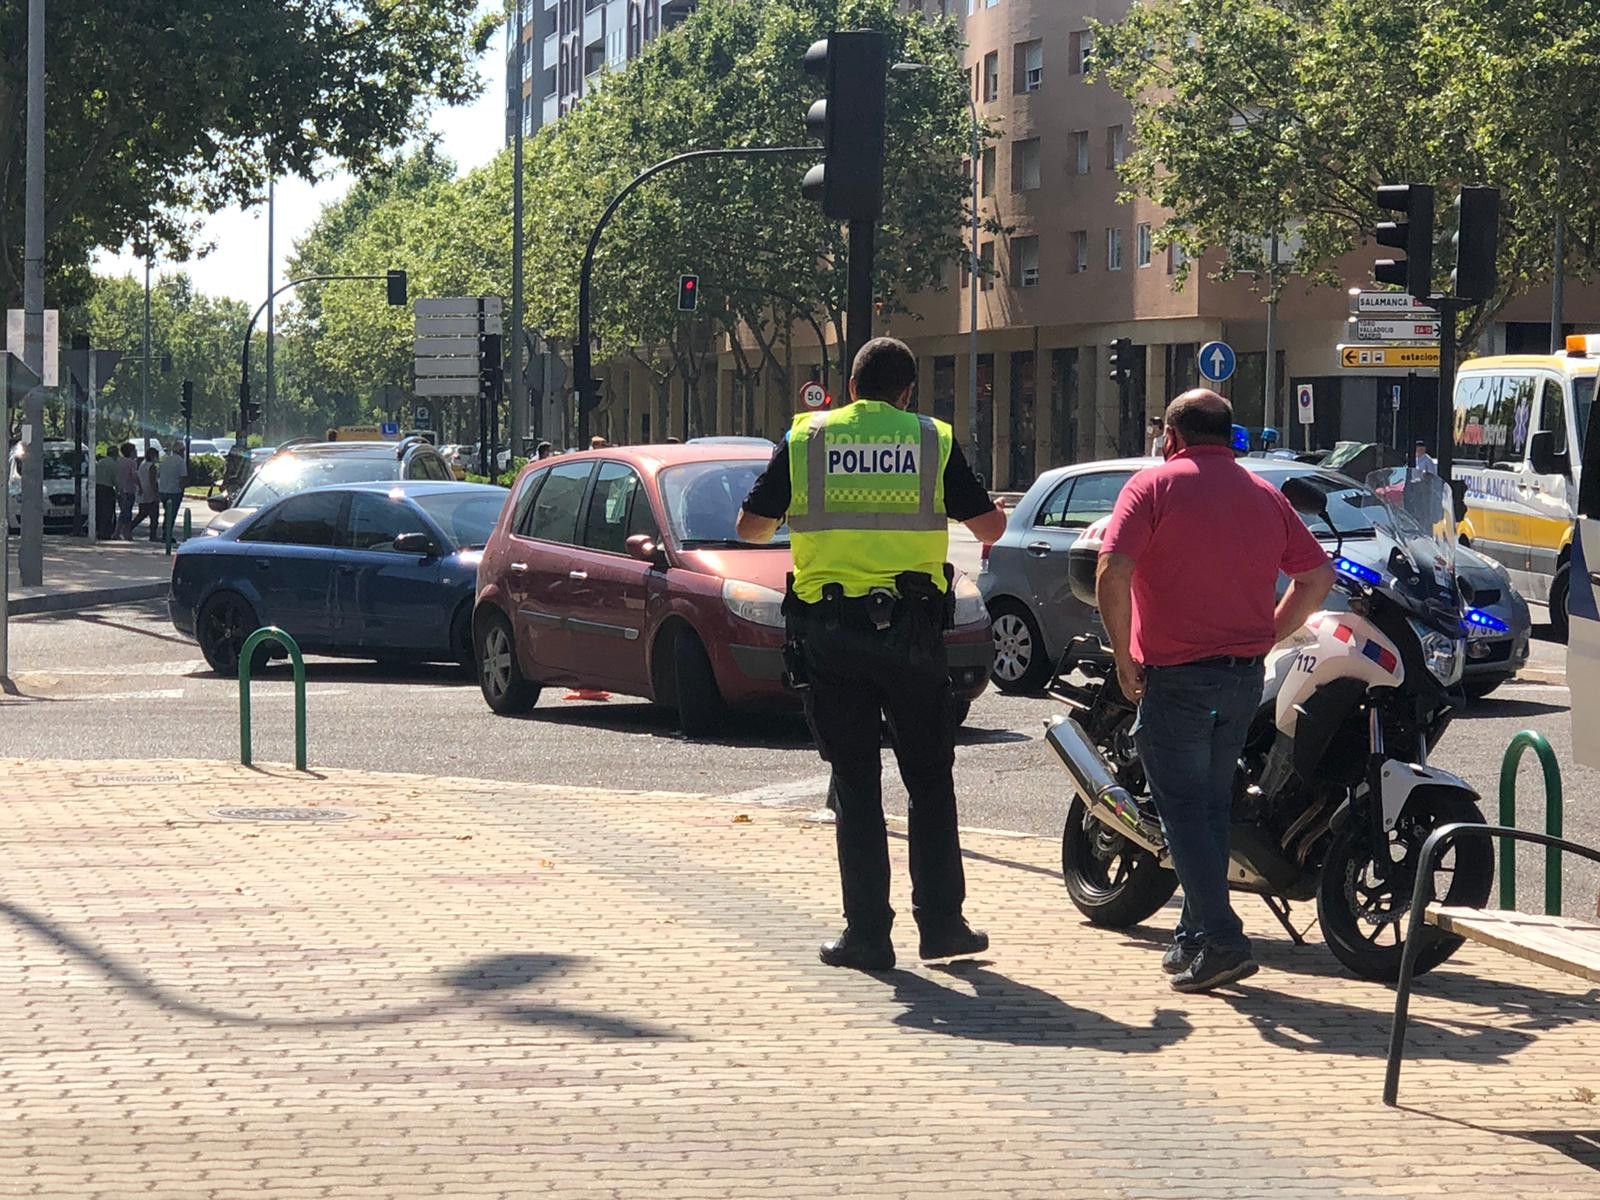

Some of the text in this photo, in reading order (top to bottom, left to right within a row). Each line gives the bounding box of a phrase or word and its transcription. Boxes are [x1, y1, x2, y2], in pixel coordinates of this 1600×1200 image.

[1360, 298, 1408, 306] SALAMANCA
[1401, 353, 1440, 361] estacion
[808, 391, 822, 401] 50
[829, 444, 916, 473] POLICÍA
[1455, 474, 1518, 502] BULANCIA
[1297, 653, 1316, 674] 112
